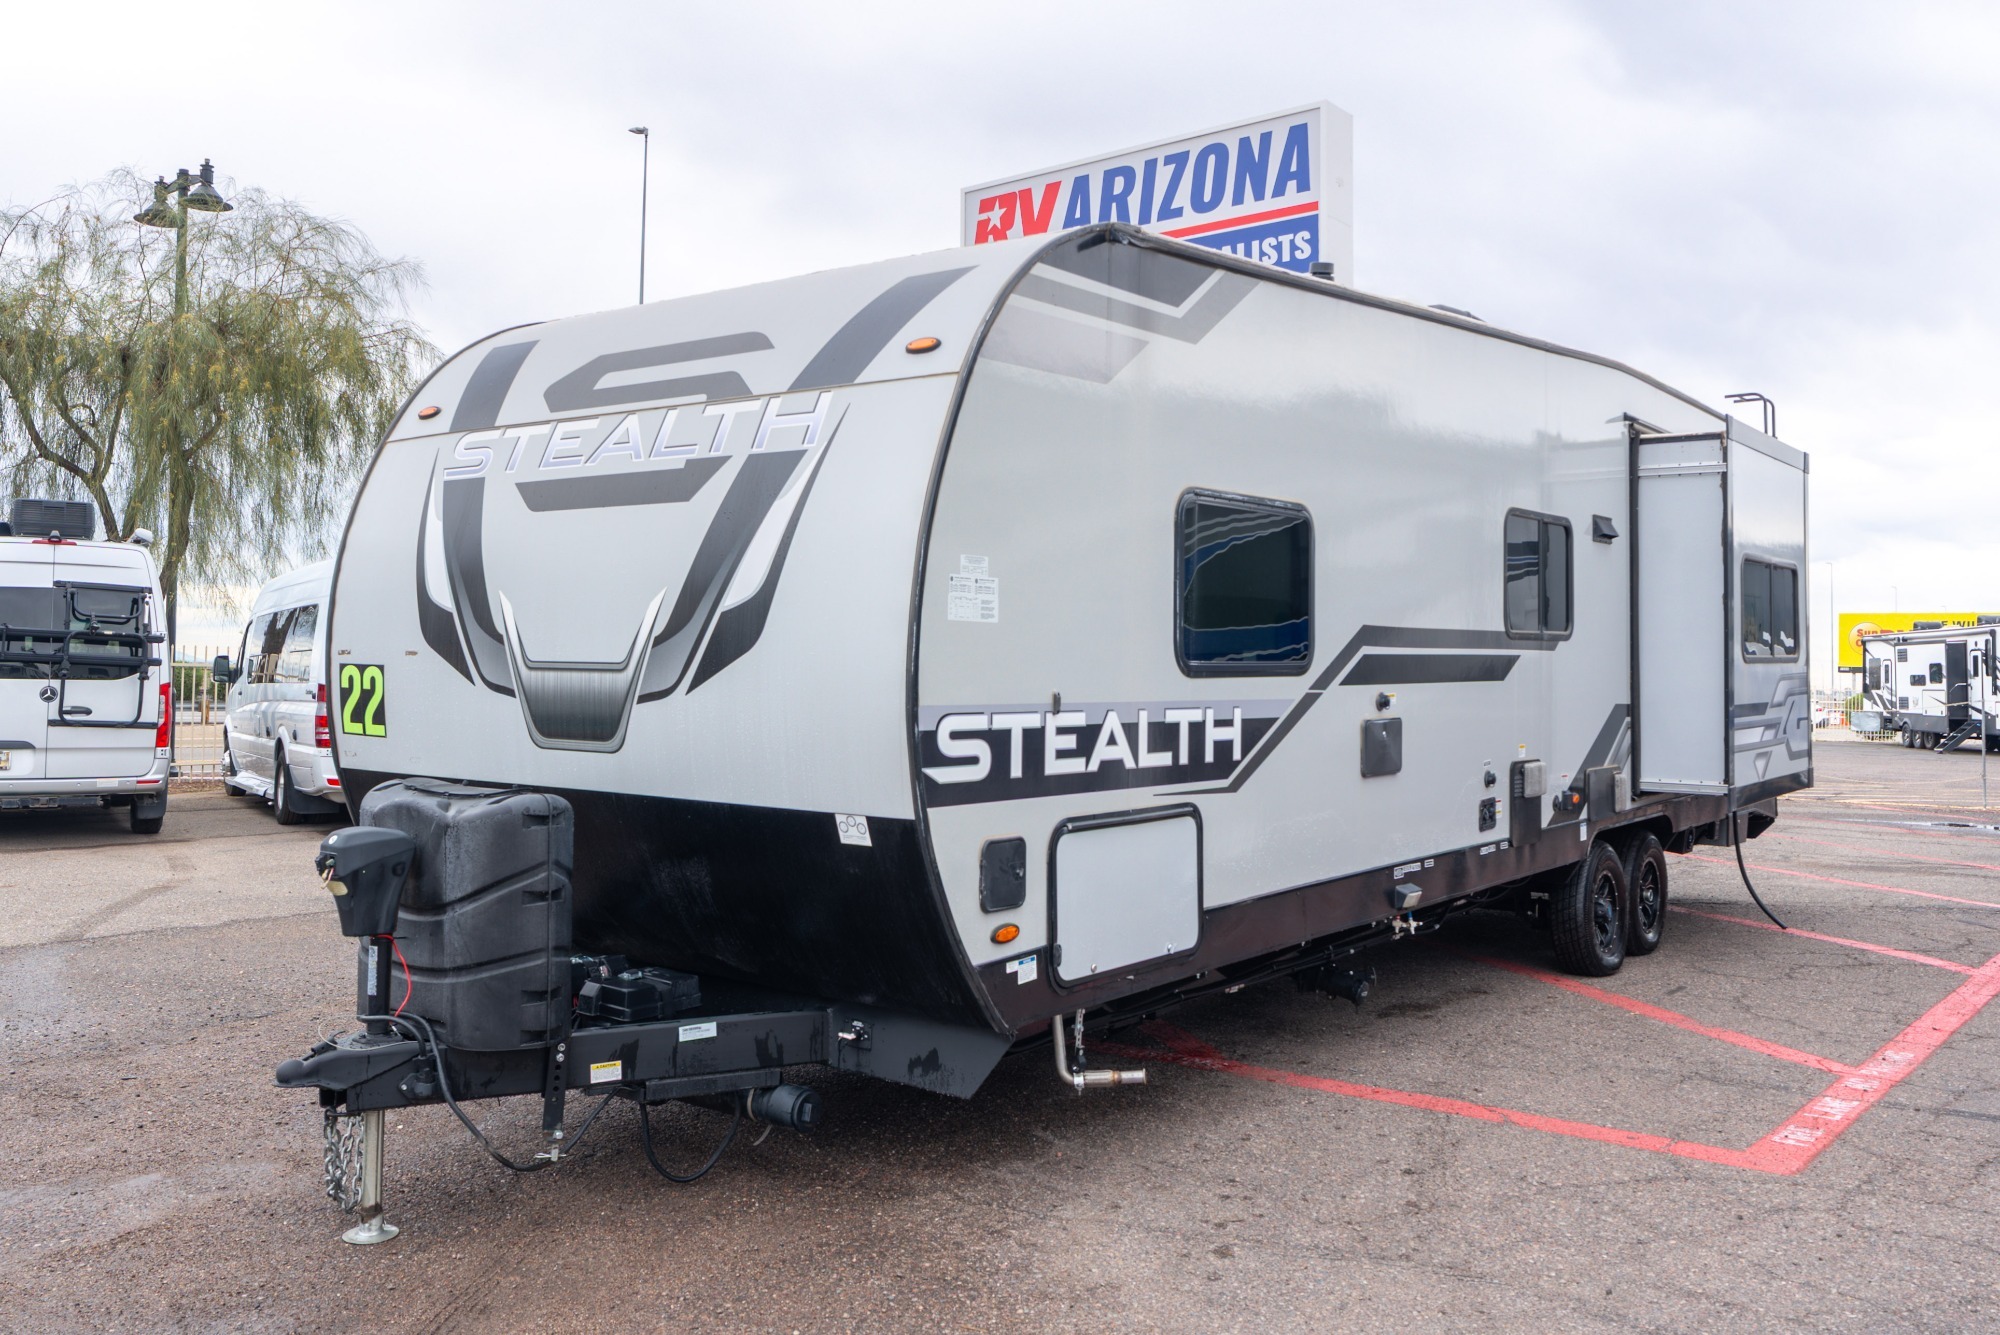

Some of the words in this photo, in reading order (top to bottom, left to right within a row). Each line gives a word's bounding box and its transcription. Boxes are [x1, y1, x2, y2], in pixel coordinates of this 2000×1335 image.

[974, 181, 1062, 245] RV
[1063, 122, 1311, 230] ARIZONA
[1222, 230, 1312, 265] ISTS
[443, 390, 834, 480] STEALTH
[341, 664, 386, 737] 22
[922, 706, 1243, 785] STEALTH
